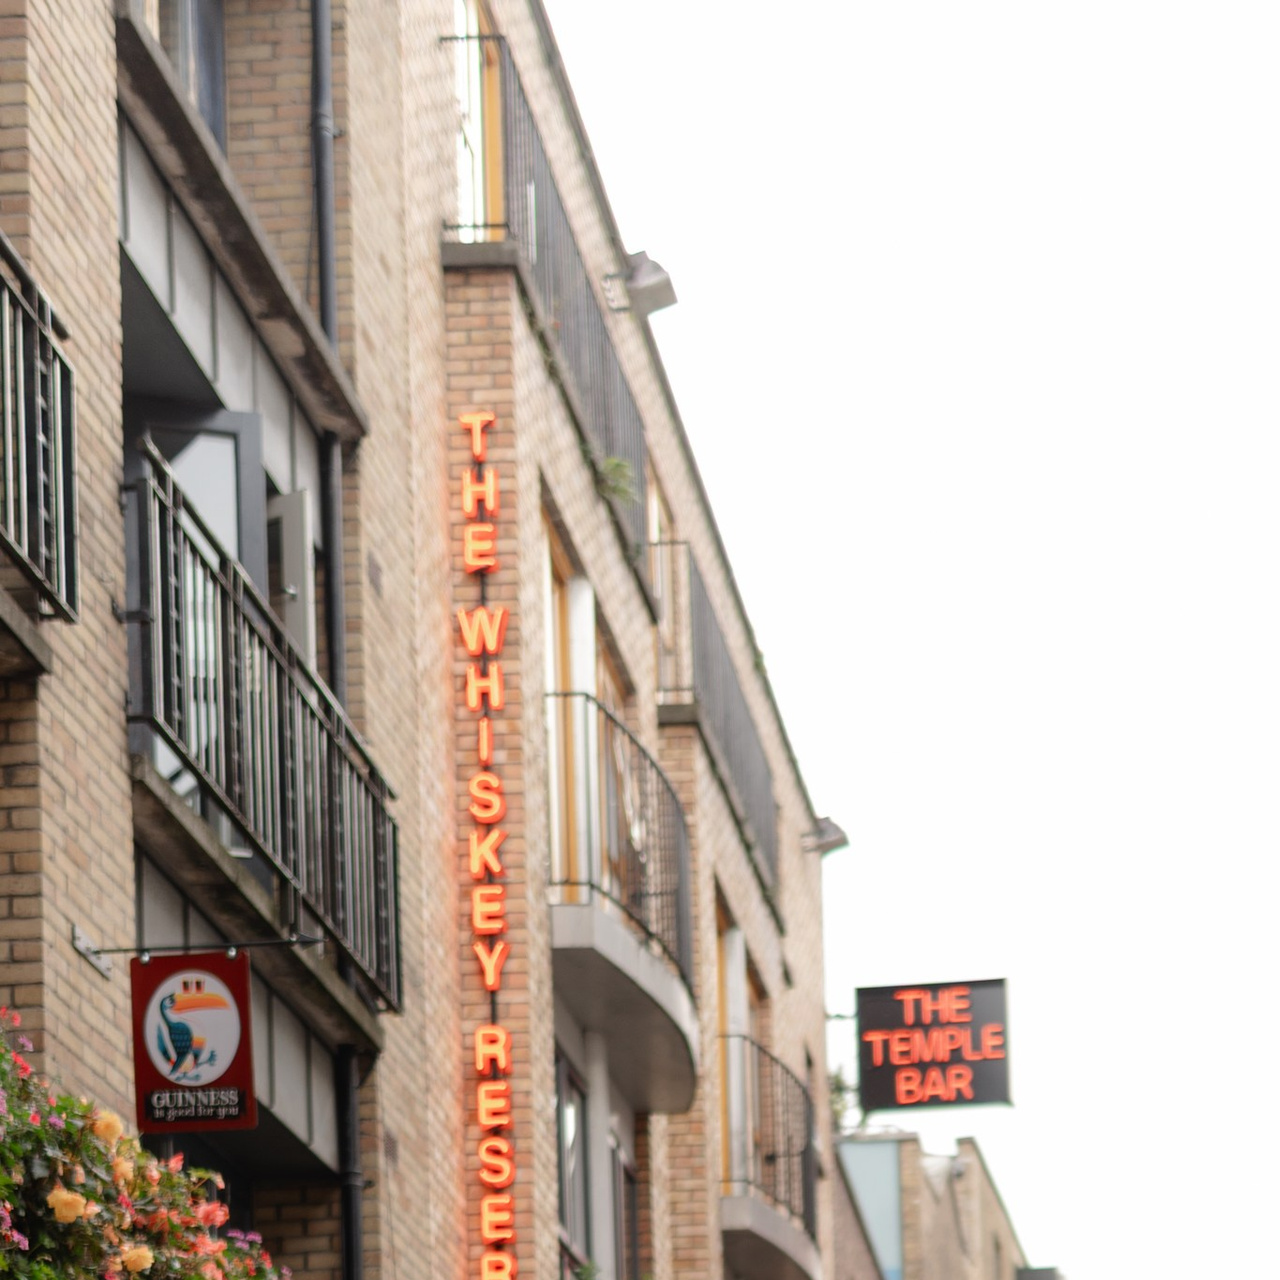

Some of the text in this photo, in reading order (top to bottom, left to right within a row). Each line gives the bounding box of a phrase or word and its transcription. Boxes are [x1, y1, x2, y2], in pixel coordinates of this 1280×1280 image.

[458, 411, 499, 575] THE
[456, 606, 512, 991] WHISKEY
[894, 985, 972, 1026] THE
[862, 1023, 1006, 1067] TEMPLE
[151, 1088, 239, 1109] GUINNESS
[895, 1064, 975, 1105] BAR
[167, 1106, 195, 1121] good
